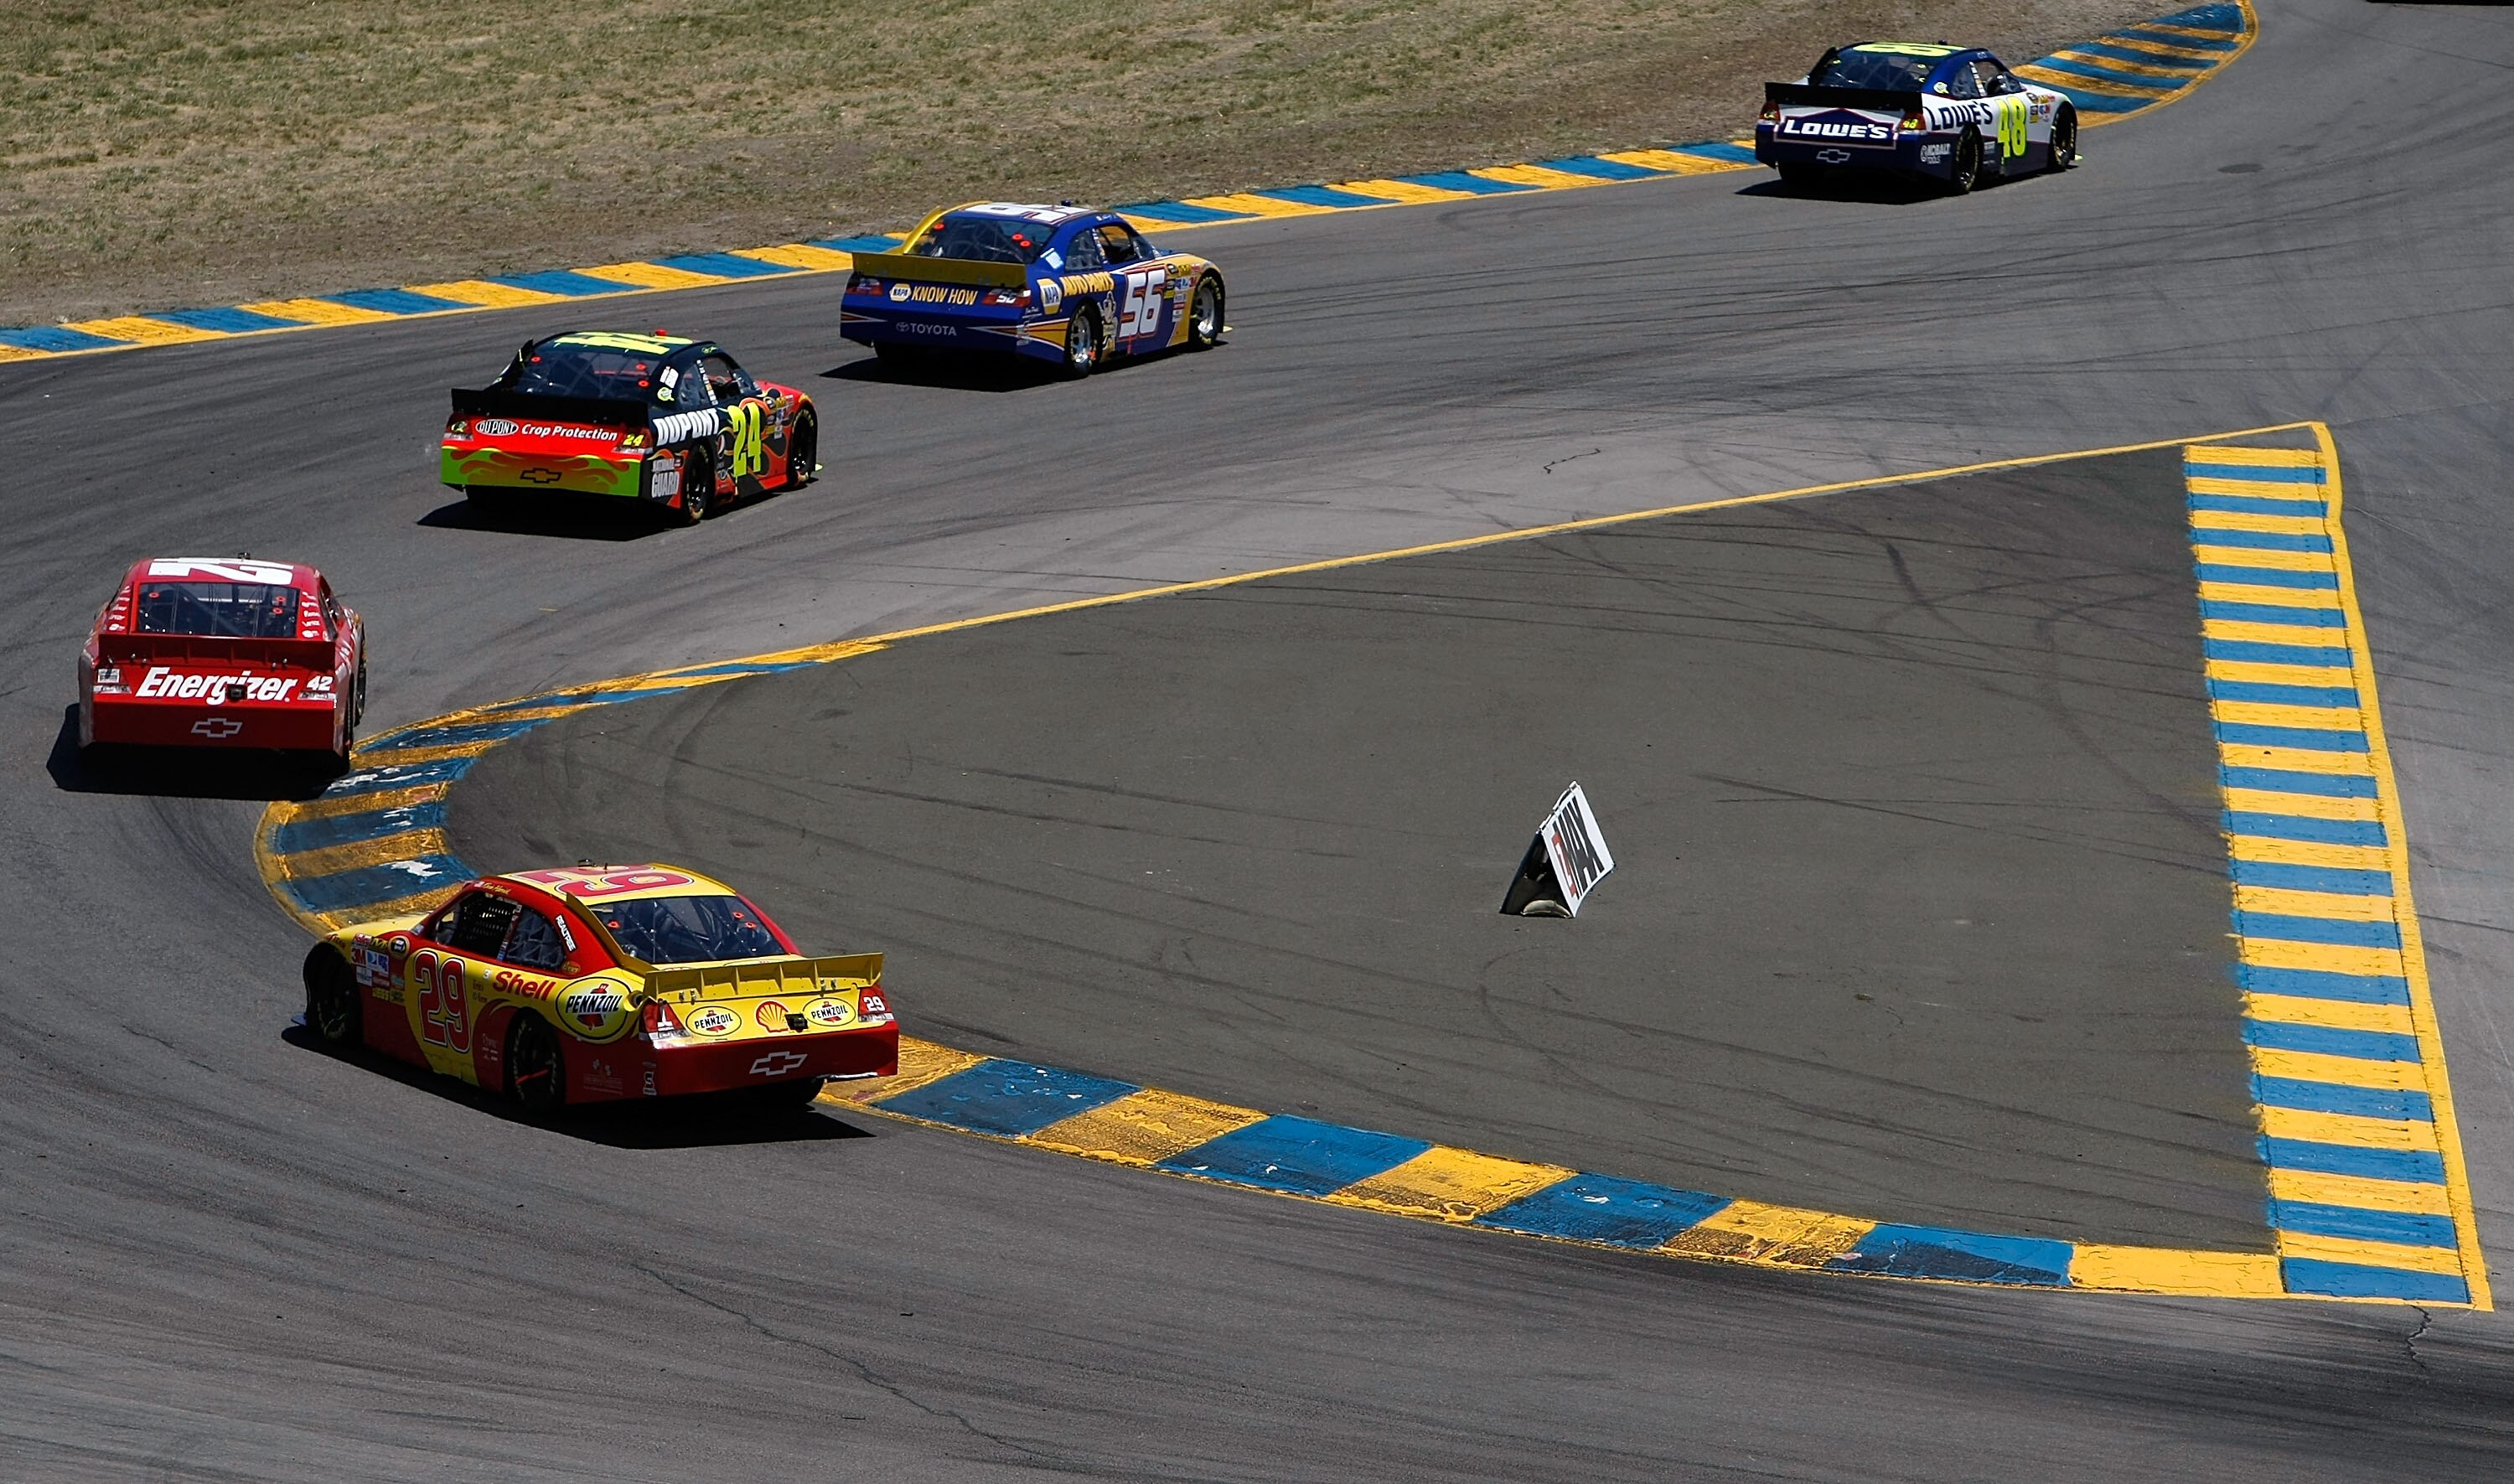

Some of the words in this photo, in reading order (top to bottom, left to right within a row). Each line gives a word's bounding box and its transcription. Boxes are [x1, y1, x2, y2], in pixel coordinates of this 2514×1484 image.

[1923, 100, 1993, 132] LOWE'S
[1783, 119, 1889, 139] LOWE'S
[1994, 96, 2027, 158] 48
[1059, 275, 1089, 297] AUTO
[1083, 272, 1115, 293] PARTS
[911, 285, 947, 303] KNOW
[947, 288, 979, 306] HOW
[1120, 268, 1166, 338] 56
[910, 323, 957, 336] TOYOTA
[521, 423, 551, 437] Crop
[551, 425, 618, 441] Protection
[652, 407, 720, 447] DUPONT
[623, 433, 644, 447] 24
[727, 401, 761, 477] 24
[652, 471, 680, 498] GUARD
[307, 675, 334, 691] 42
[555, 914, 577, 952] REALTREE
[483, 969, 492, 980] 3
[493, 970, 556, 1001] Shell
[414, 949, 472, 1054] 29
[565, 995, 623, 1014] PENNZOIL
[810, 1004, 848, 1020] PENNZOIL
[862, 995, 886, 1012] 29
[694, 1012, 733, 1030] PENNZOIL
